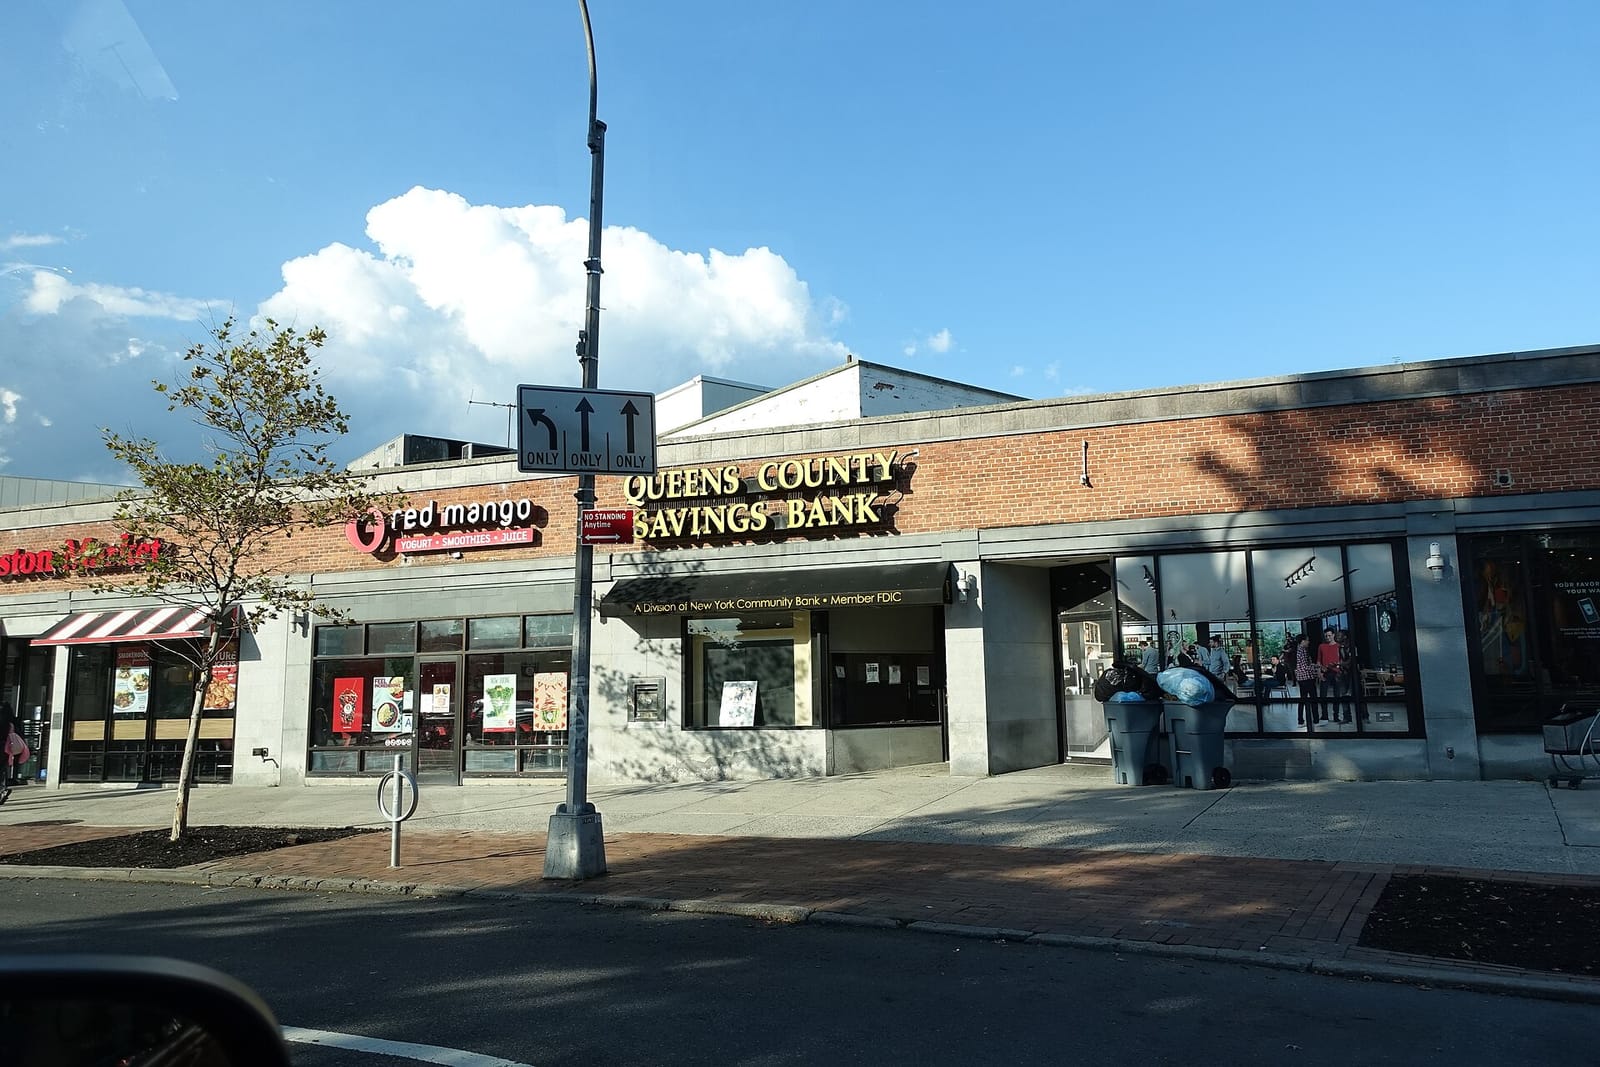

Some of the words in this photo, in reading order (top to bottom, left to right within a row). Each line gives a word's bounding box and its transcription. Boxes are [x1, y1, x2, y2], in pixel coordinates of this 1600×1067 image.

[527, 452, 559, 465] ONLY
[571, 453, 602, 467] ONLY
[616, 455, 646, 468] ONLY
[623, 465, 740, 506] QUEENS
[758, 450, 898, 491] COUNTY
[391, 500, 434, 529] red
[444, 498, 531, 527] mango
[633, 502, 768, 539] SAVINGS
[786, 492, 880, 528] BANK
[584, 521, 611, 529] Anytime
[401, 538, 433, 550] YOGURT
[442, 534, 491, 547] SMOOTHIES
[501, 531, 528, 543] JUICE
[634, 604, 641, 613] A
[643, 603, 676, 613] Division
[679, 602, 688, 611] of
[690, 601, 713, 610] New
[714, 600, 735, 609] York
[737, 597, 793, 609] Community
[795, 596, 821, 606] Bank
[830, 594, 875, 605] Member
[877, 591, 902, 603] FDIC
[404, 718, 412, 728] A
